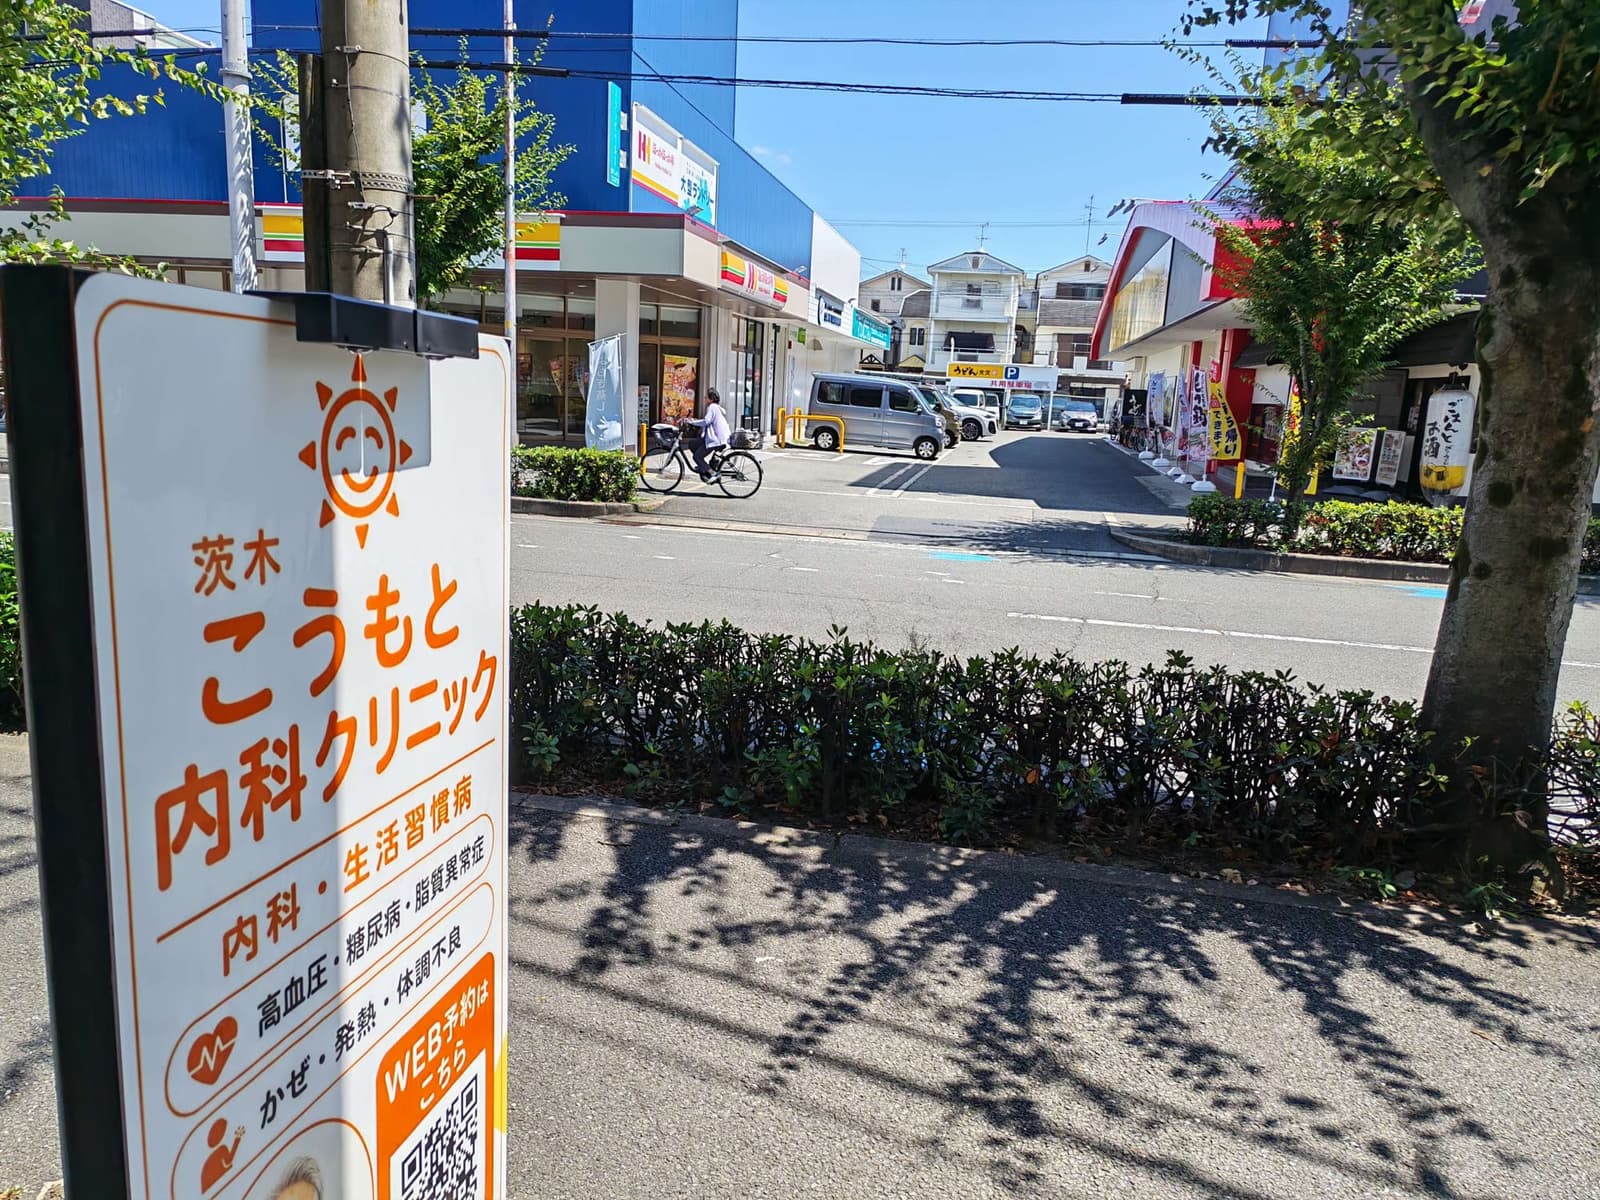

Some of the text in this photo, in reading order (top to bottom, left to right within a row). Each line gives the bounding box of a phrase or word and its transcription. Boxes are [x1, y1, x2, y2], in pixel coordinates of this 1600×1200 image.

[680, 175, 714, 207] 大型ランドリー
[1423, 420, 1441, 458] お酒
[192, 529, 281, 596] 茨木
[201, 563, 460, 725] こうもと
[154, 650, 497, 891] 内科クリニック
[384, 979, 489, 1104] WEB予約は
[419, 1039, 468, 1111] こちら
